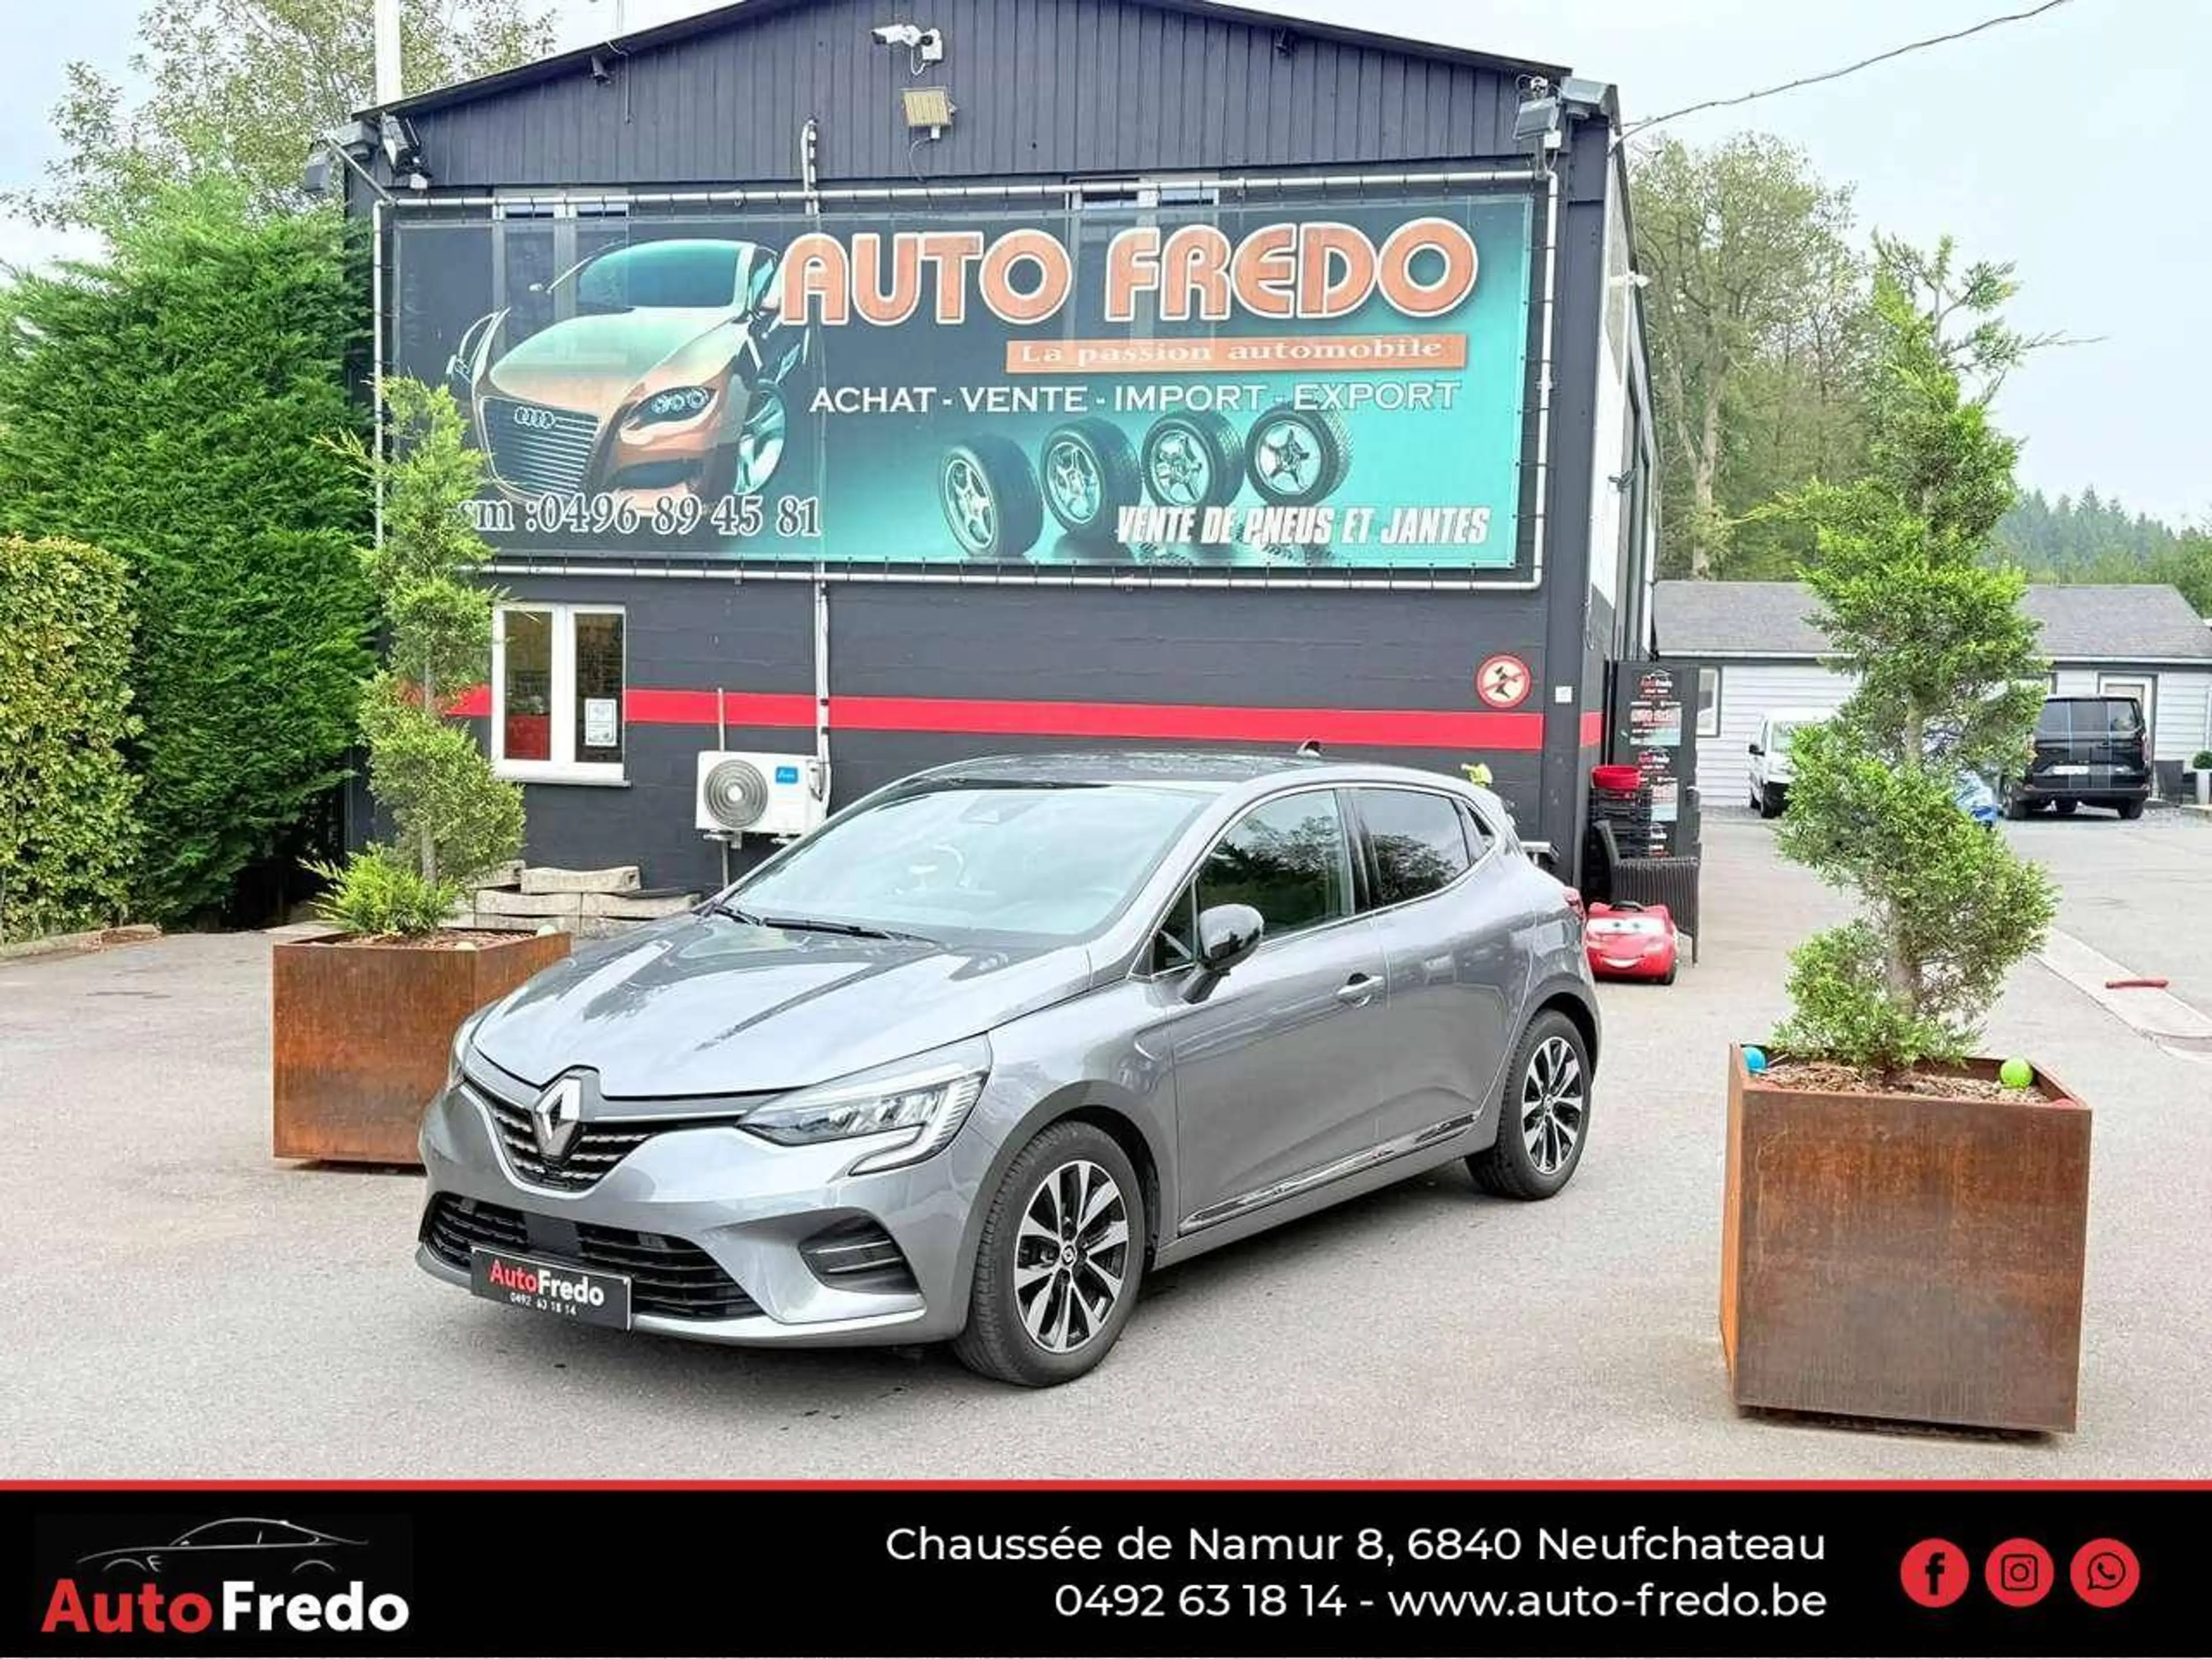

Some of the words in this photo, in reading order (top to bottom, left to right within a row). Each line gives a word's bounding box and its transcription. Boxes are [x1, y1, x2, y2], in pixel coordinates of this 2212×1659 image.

[781, 229, 1072, 325] AUTO
[1105, 217, 1479, 322] FREDO
[1021, 346, 1063, 363] La
[1078, 342, 1211, 369] passion
[1228, 338, 1442, 361] automobile
[809, 387, 937, 414] ACHAT
[960, 386, 1088, 412] VENTE
[1114, 384, 1267, 411] IMPORT
[1293, 380, 1461, 410] EXPORT
[445, 498, 516, 532] sm
[652, 493, 702, 535] 89
[711, 493, 764, 535] 45
[775, 495, 821, 537] 81
[1116, 506, 1195, 543] VENTE
[1200, 506, 1234, 543] DE
[1243, 506, 1335, 543] PNEUS
[1340, 506, 1376, 543] ET
[1380, 506, 1492, 543] JANTES
